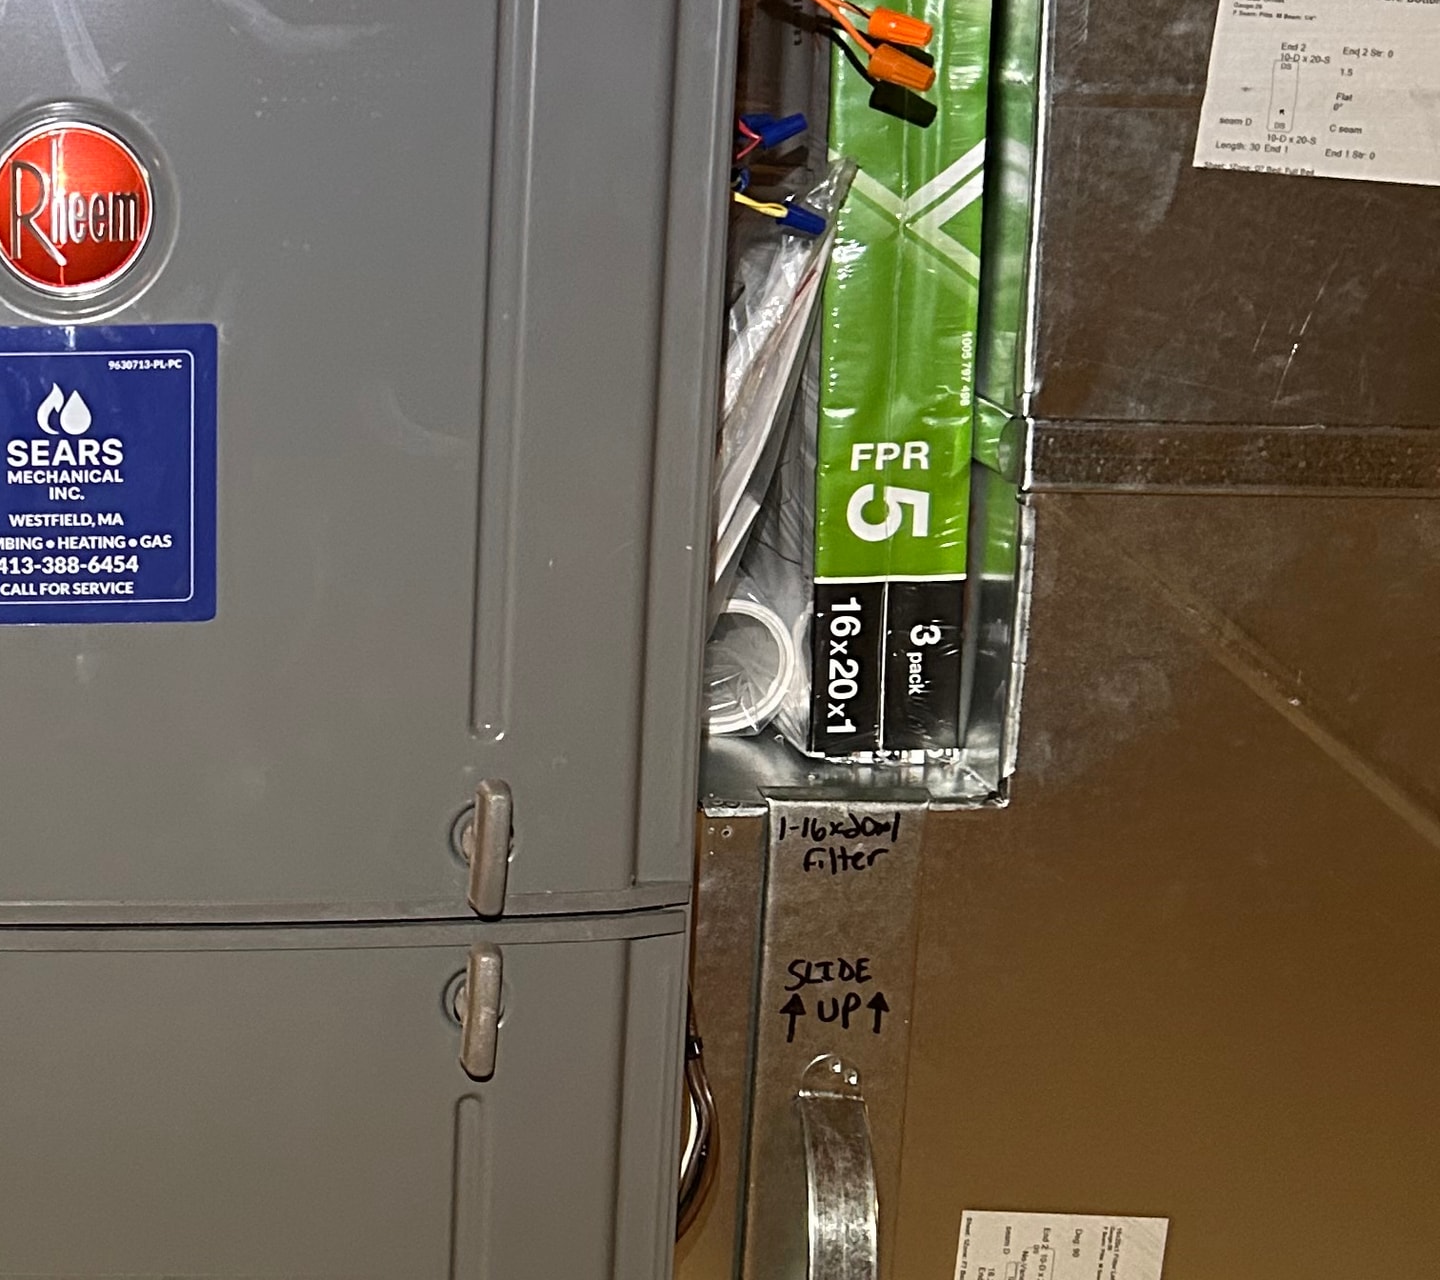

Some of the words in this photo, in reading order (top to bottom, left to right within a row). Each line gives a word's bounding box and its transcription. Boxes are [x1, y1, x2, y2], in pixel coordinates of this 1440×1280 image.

[1281, 43, 1299, 52] End
[1300, 44, 1306, 52] 2
[1361, 48, 1368, 57] 2
[1340, 68, 1353, 76] 1.5
[1336, 93, 1353, 102] Flat
[1245, 118, 1252, 126] D
[1329, 125, 1336, 133] C
[1339, 126, 1362, 134] seam
[1250, 143, 1260, 152] 30
[1264, 144, 1281, 154] End
[1325, 149, 1342, 158] End
[1369, 151, 1375, 160] 0
[9, 133, 141, 266] Rheem
[961, 331, 972, 359] 1005
[108, 359, 182, 370] 9630713-PL-PC
[6, 438, 124, 467] SEARS
[850, 441, 930, 472] FPR
[7, 469, 124, 484] MECHANICAL
[49, 486, 85, 501] INC.
[9, 513, 97, 528] WESTFIELD,
[97, 512, 124, 526] MA
[846, 483, 930, 543] 5
[57, 535, 126, 550] HEATING
[140, 534, 172, 549] GAS
[0, 582, 38, 596] CALL
[39, 582, 71, 596] FOR
[73, 581, 134, 595] SERVICE
[909, 624, 942, 646] 3
[827, 596, 861, 736] 16x20x1
[906, 652, 925, 696] pack
[784, 957, 872, 991] SLIDE
[817, 992, 862, 1029] UP
[1041, 1228, 1051, 1243] End
[1072, 1248, 1080, 1258] 90
